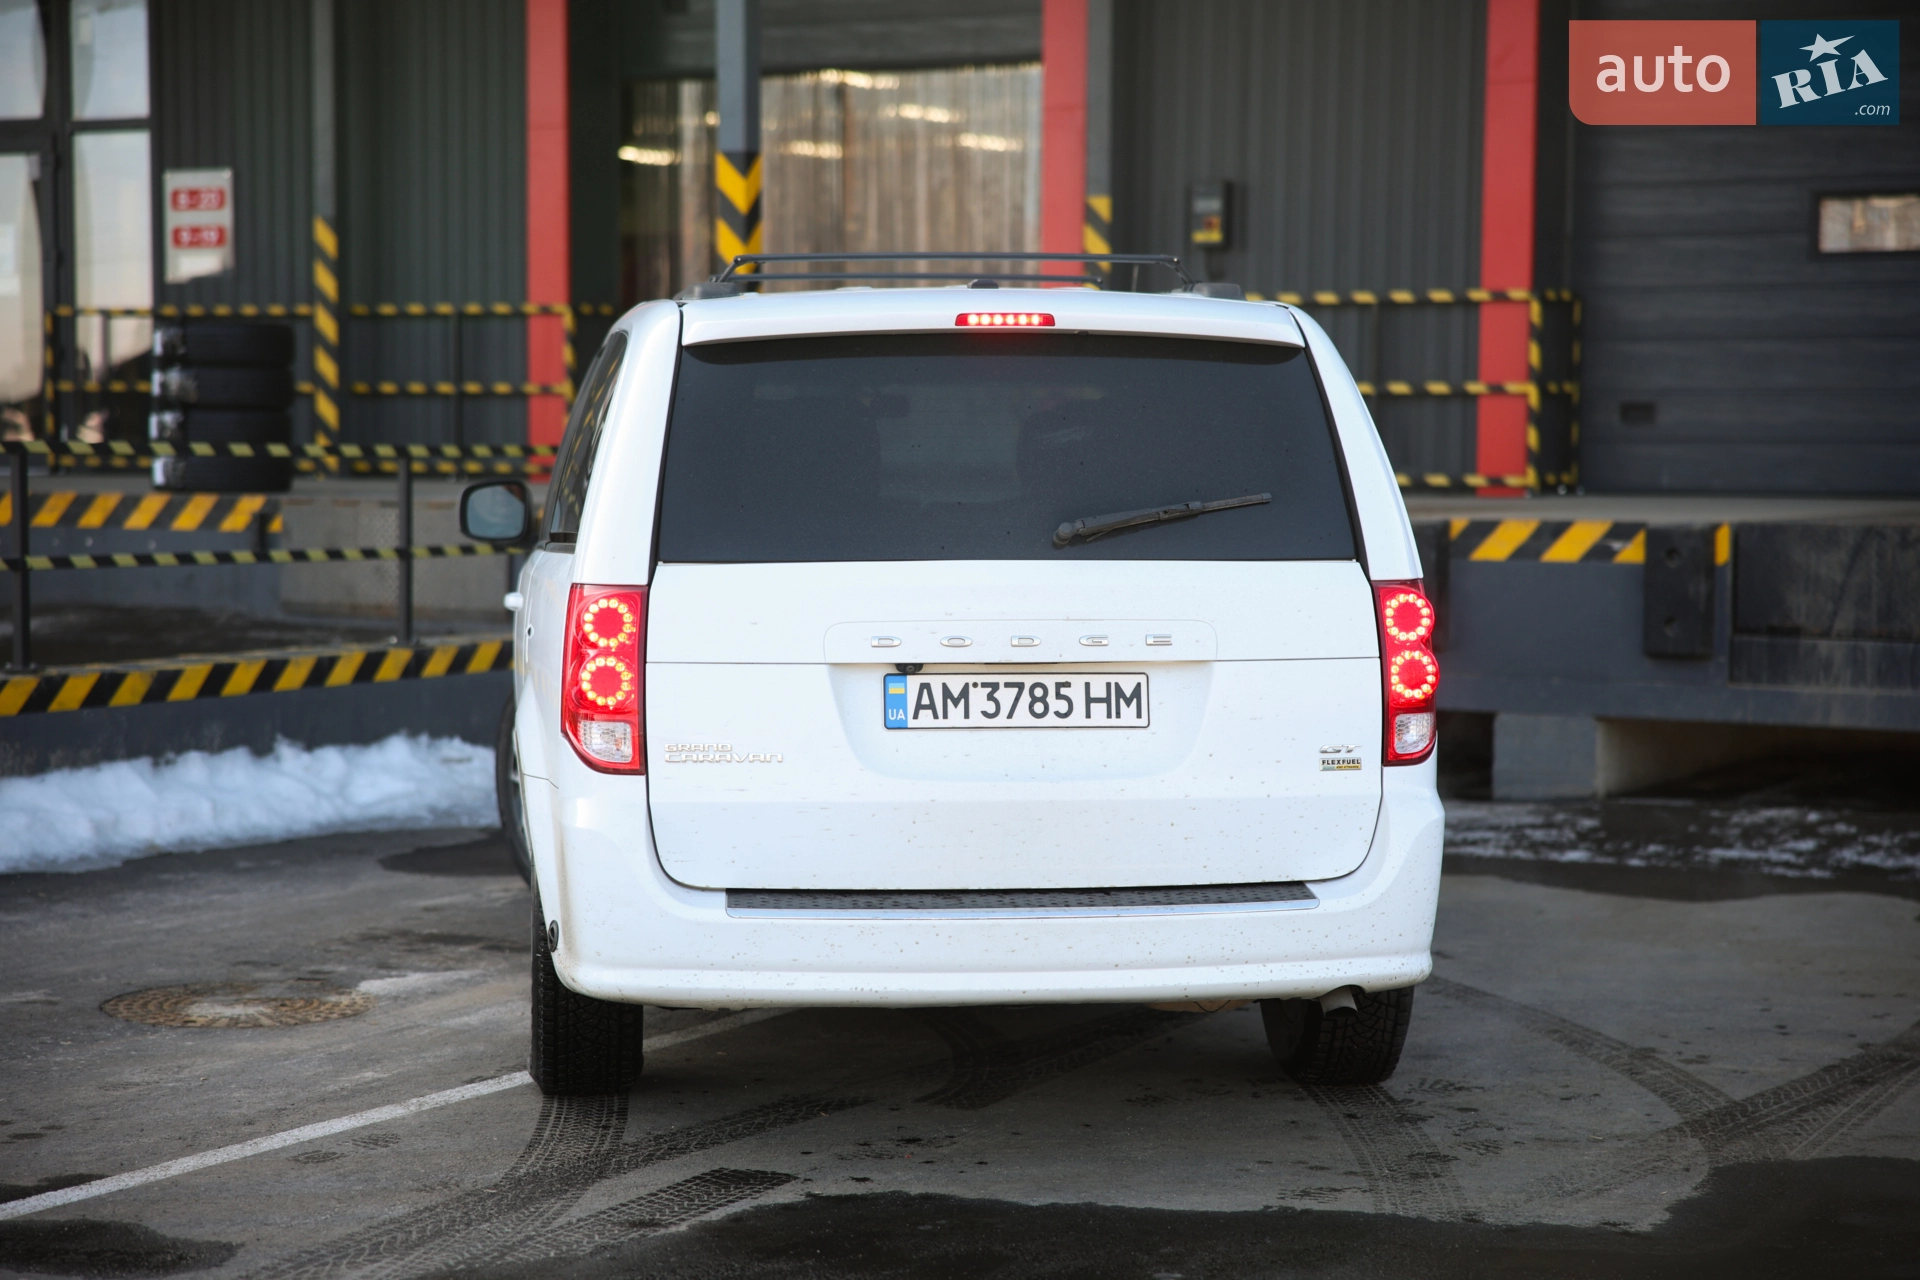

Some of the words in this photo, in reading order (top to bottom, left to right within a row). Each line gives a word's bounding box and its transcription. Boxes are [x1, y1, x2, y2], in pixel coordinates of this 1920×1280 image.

[871, 633, 1173, 648] DODGE
[980, 681, 1074, 720] 3785
[888, 708, 906, 721] UA
[664, 743, 732, 752] GRAND
[664, 753, 783, 763] CARAVAN
